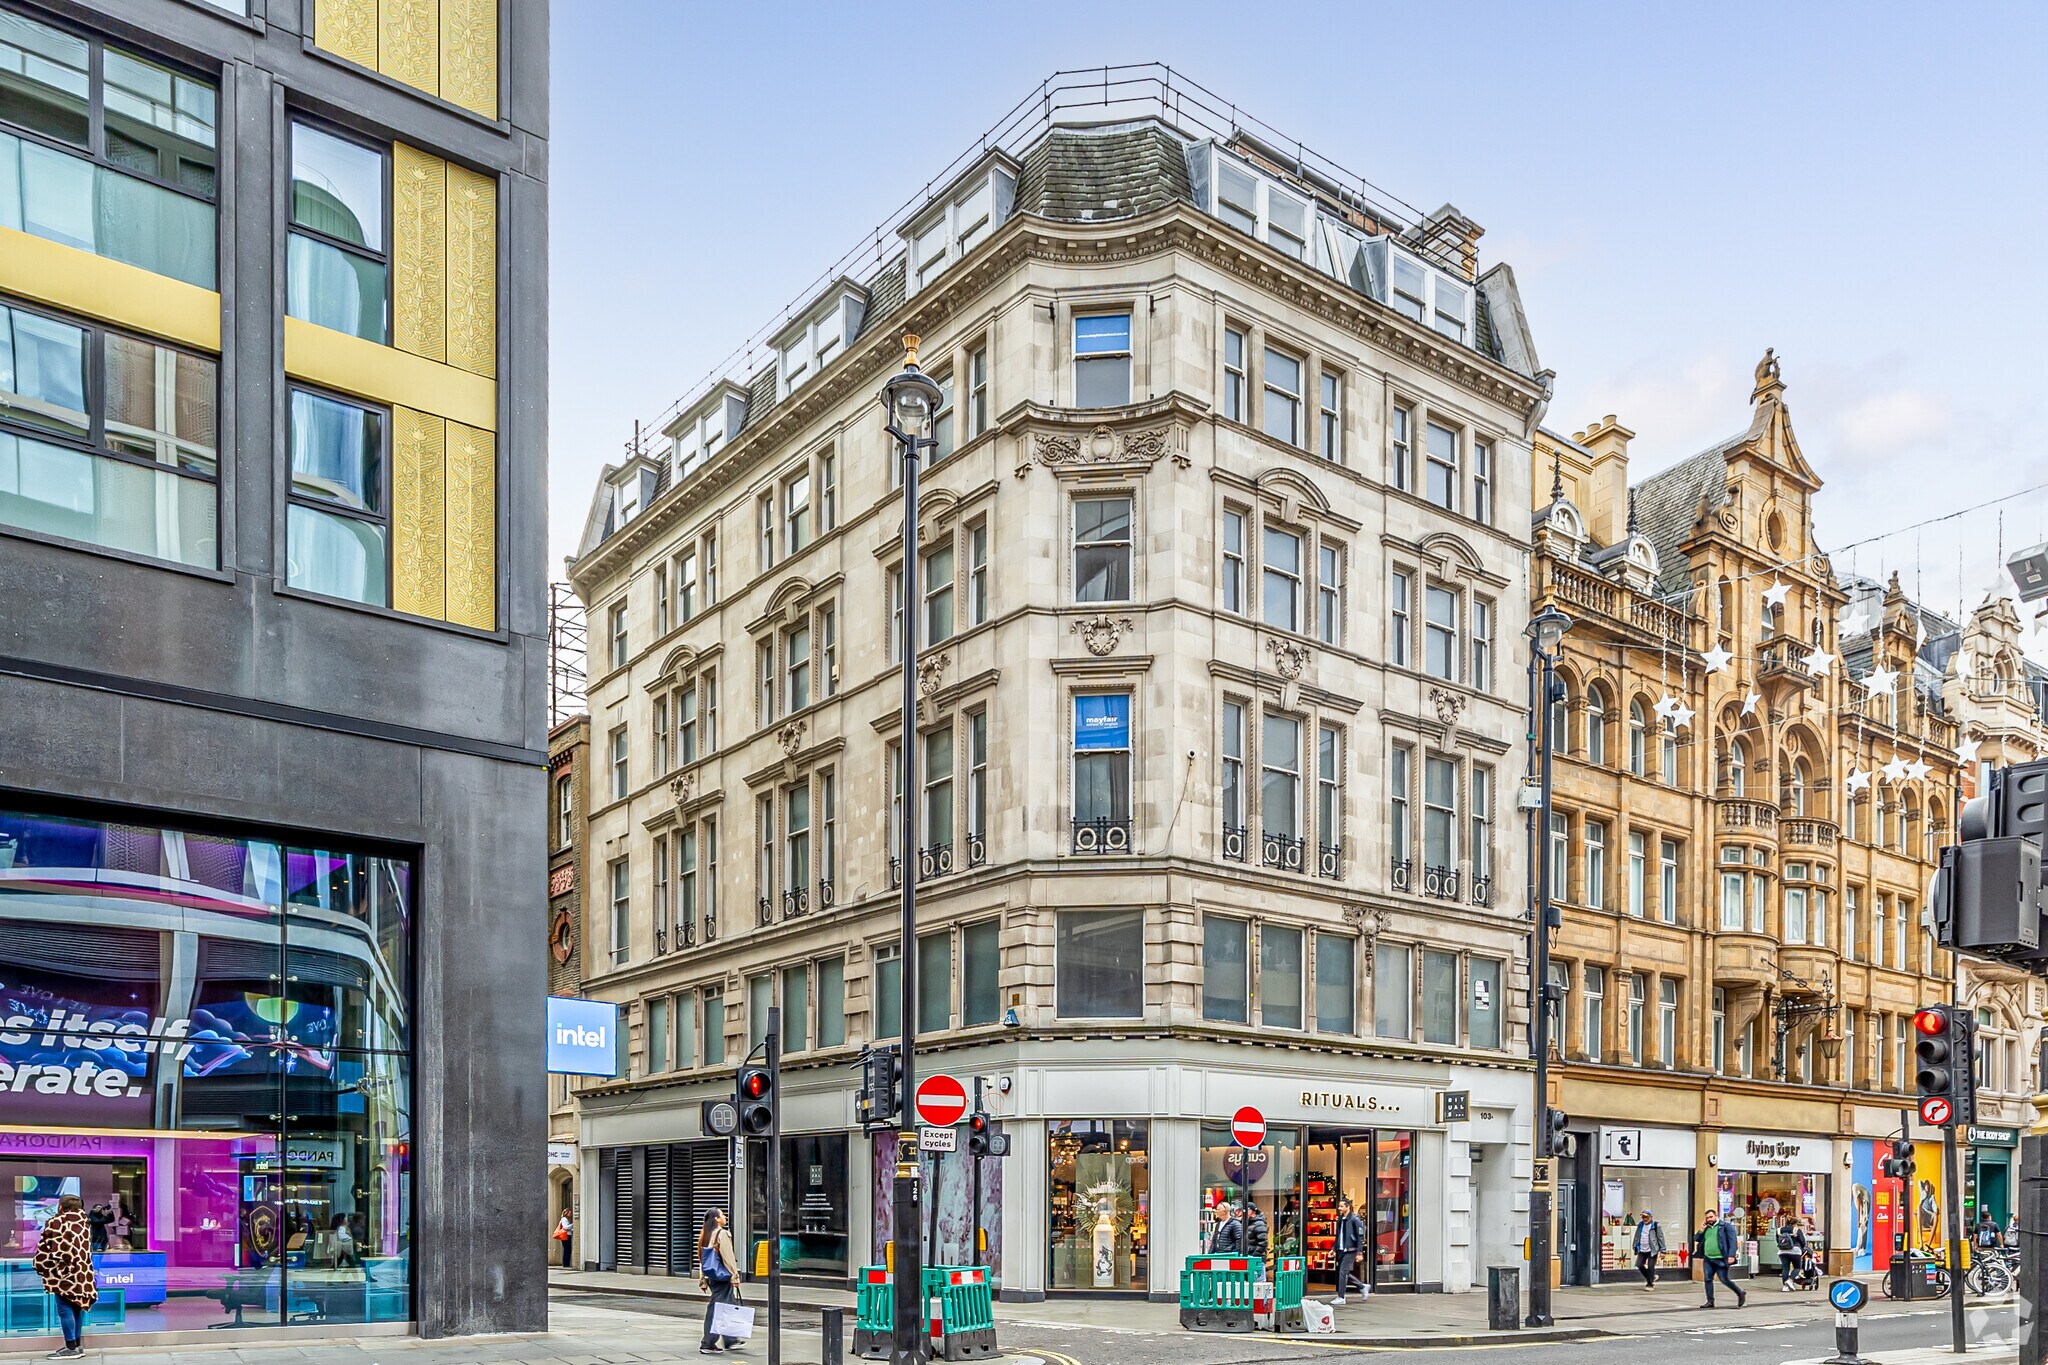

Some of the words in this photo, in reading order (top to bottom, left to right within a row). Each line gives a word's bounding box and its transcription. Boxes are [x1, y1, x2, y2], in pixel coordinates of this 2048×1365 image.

[1086, 715, 1118, 723] mayfair
[41, 1009, 194, 1061] itself,
[556, 1022, 606, 1048] intel
[1301, 1092, 1400, 1111] RITUALS...
[924, 1130, 953, 1139] Except
[1976, 1130, 1986, 1139] THE
[1986, 1131, 1998, 1140] BODY
[1998, 1132, 2011, 1141] SHOP
[924, 1140, 952, 1148] cycles
[1746, 1139, 1775, 1158] flying
[1776, 1141, 1800, 1159] tiger
[105, 1273, 134, 1284] intel
